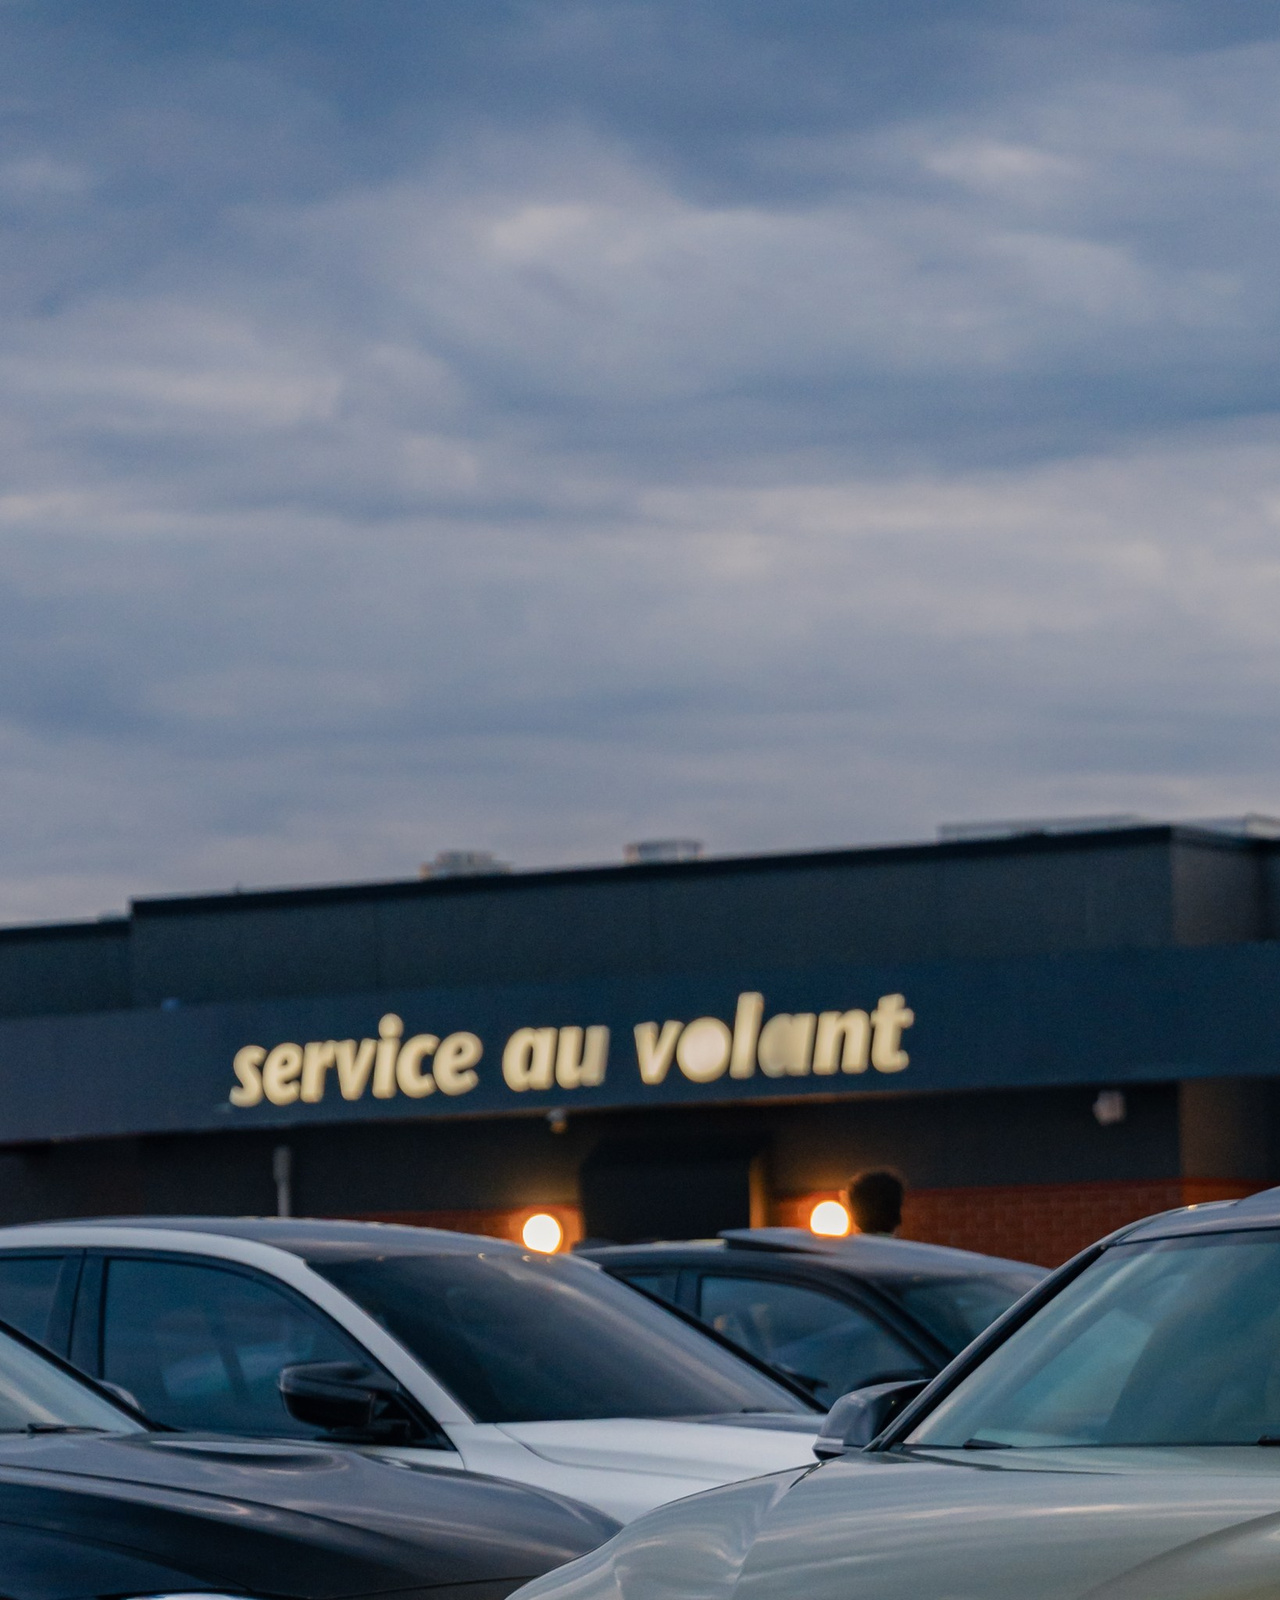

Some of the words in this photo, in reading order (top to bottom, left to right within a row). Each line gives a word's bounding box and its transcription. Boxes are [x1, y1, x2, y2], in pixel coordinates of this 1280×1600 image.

[230, 1014, 482, 1106] service
[502, 1025, 608, 1091] au
[634, 992, 914, 1083] volant
